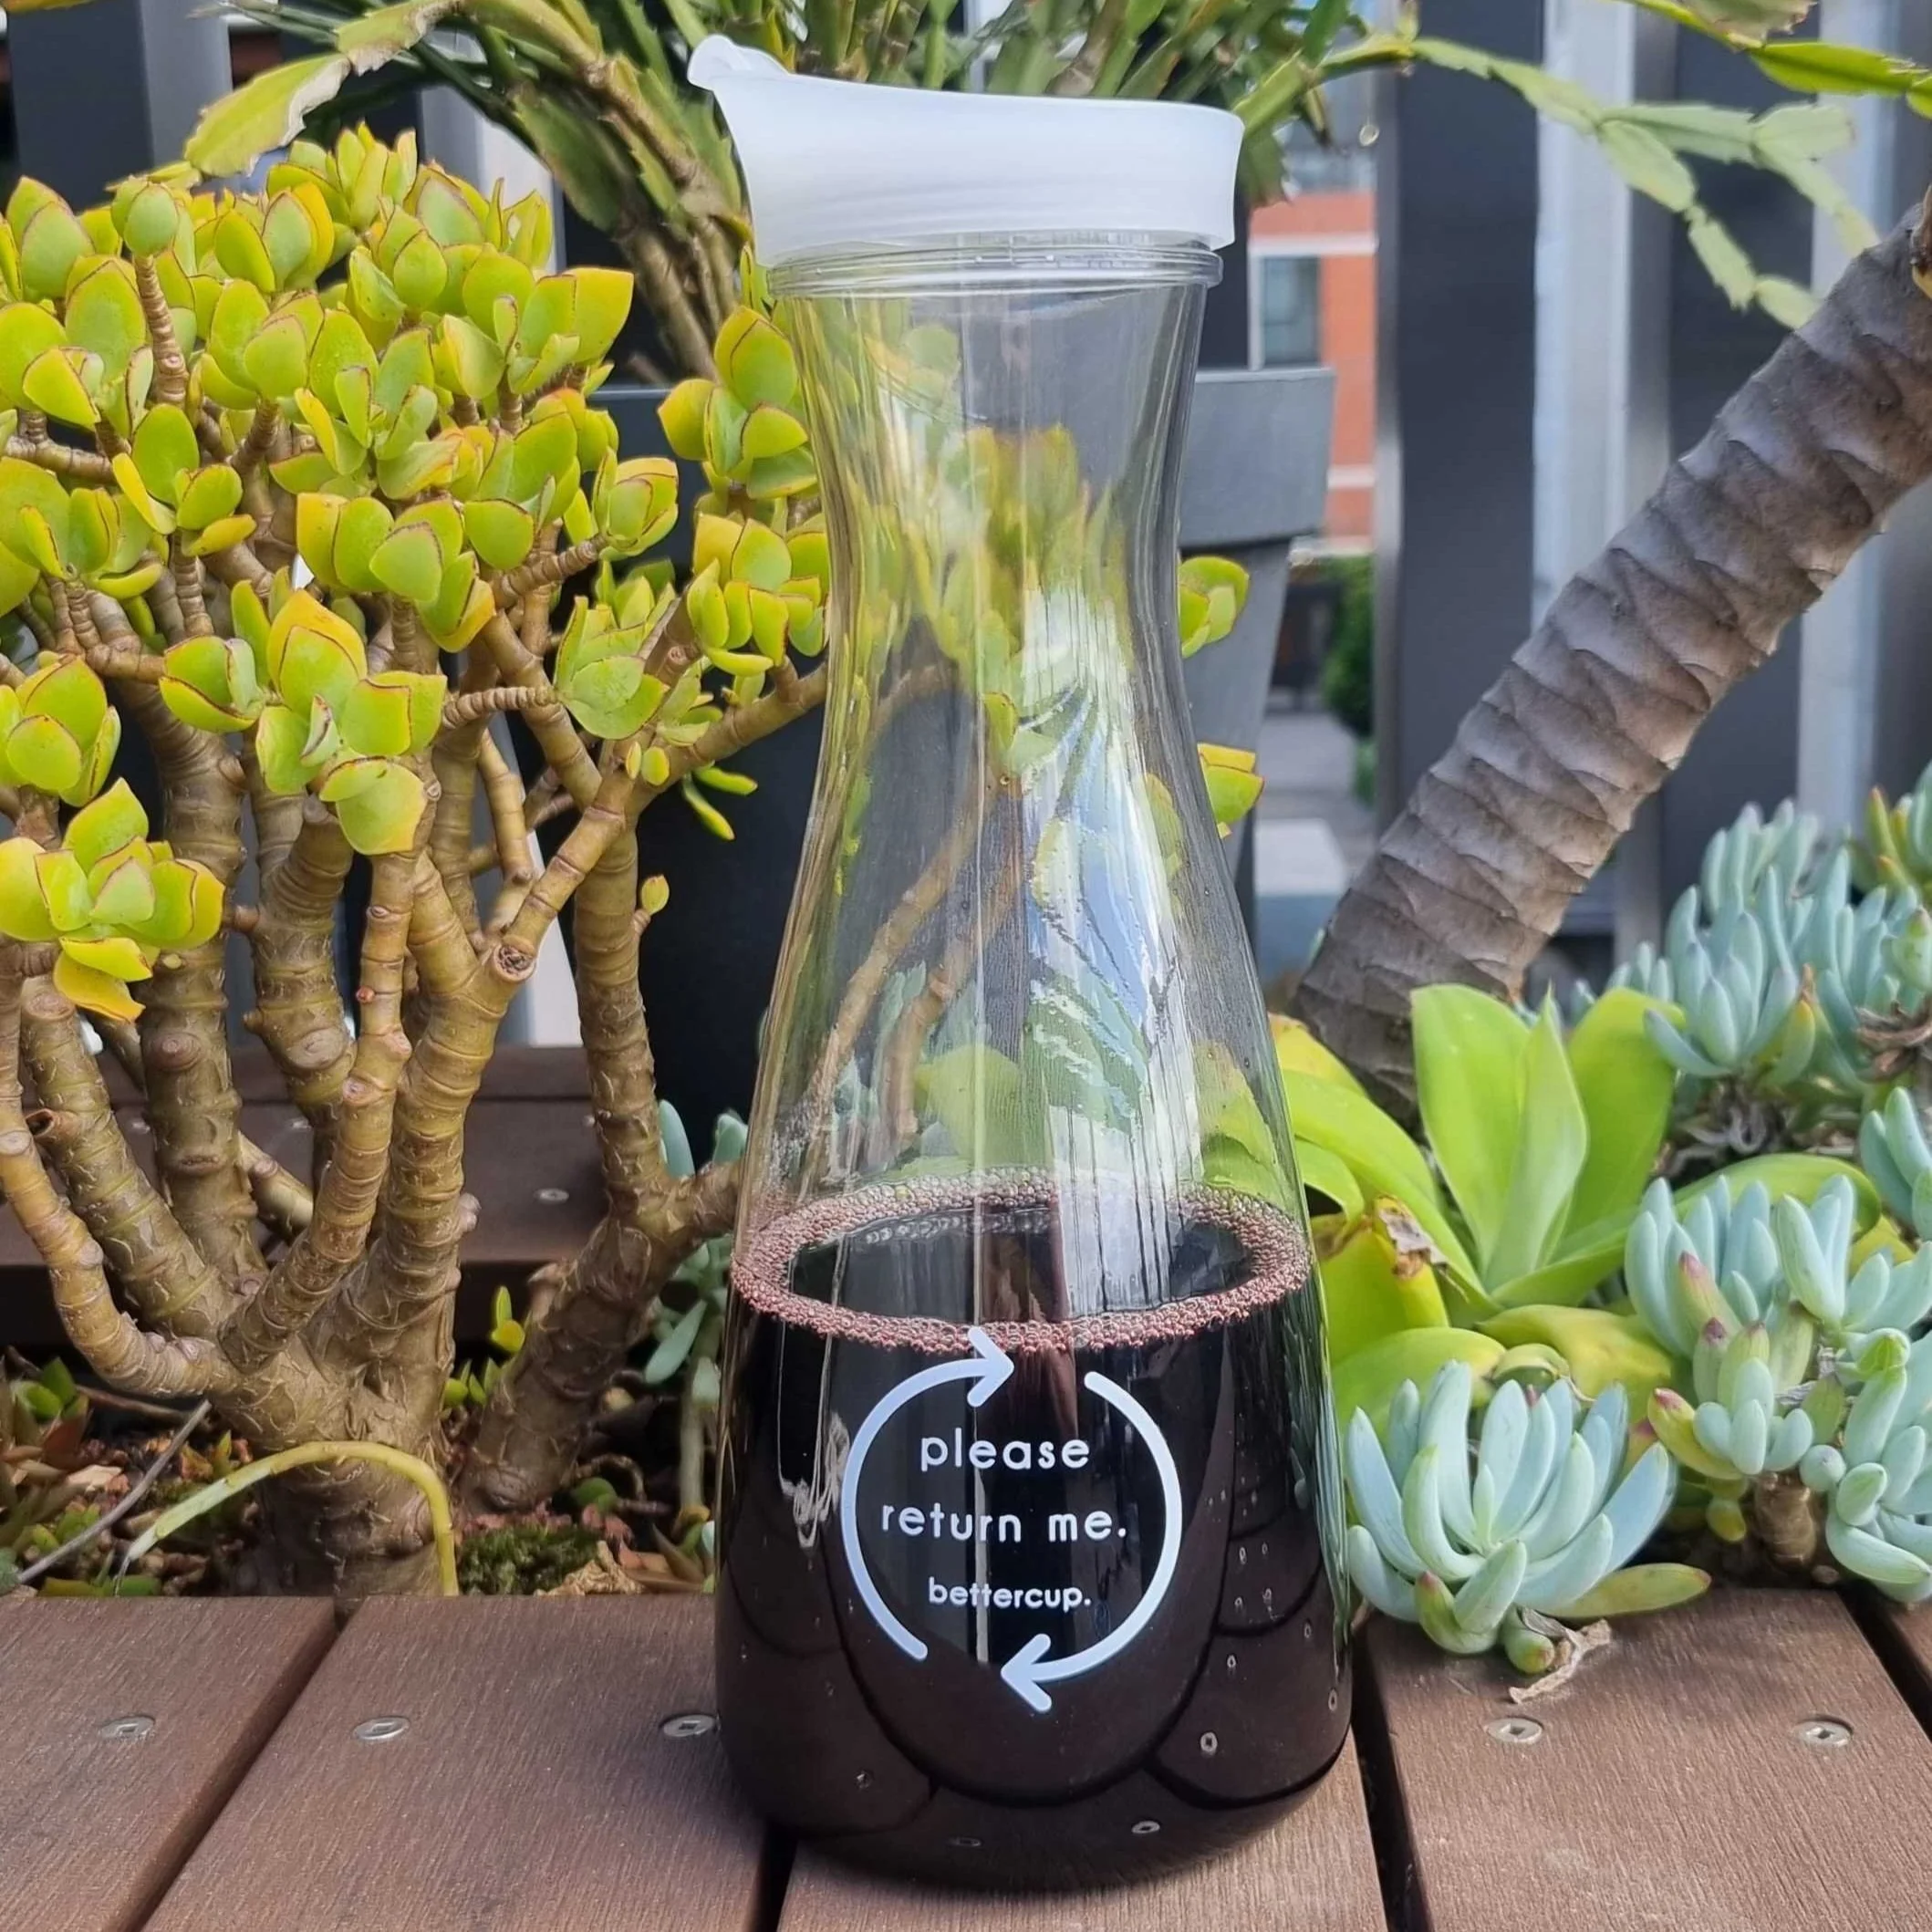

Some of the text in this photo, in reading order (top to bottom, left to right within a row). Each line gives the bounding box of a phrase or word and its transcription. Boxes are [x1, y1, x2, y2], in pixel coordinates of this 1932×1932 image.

[920, 1427, 1090, 1472] please
[881, 1502, 1127, 1542] return me.
[928, 1576, 1092, 1613] bettercup.
